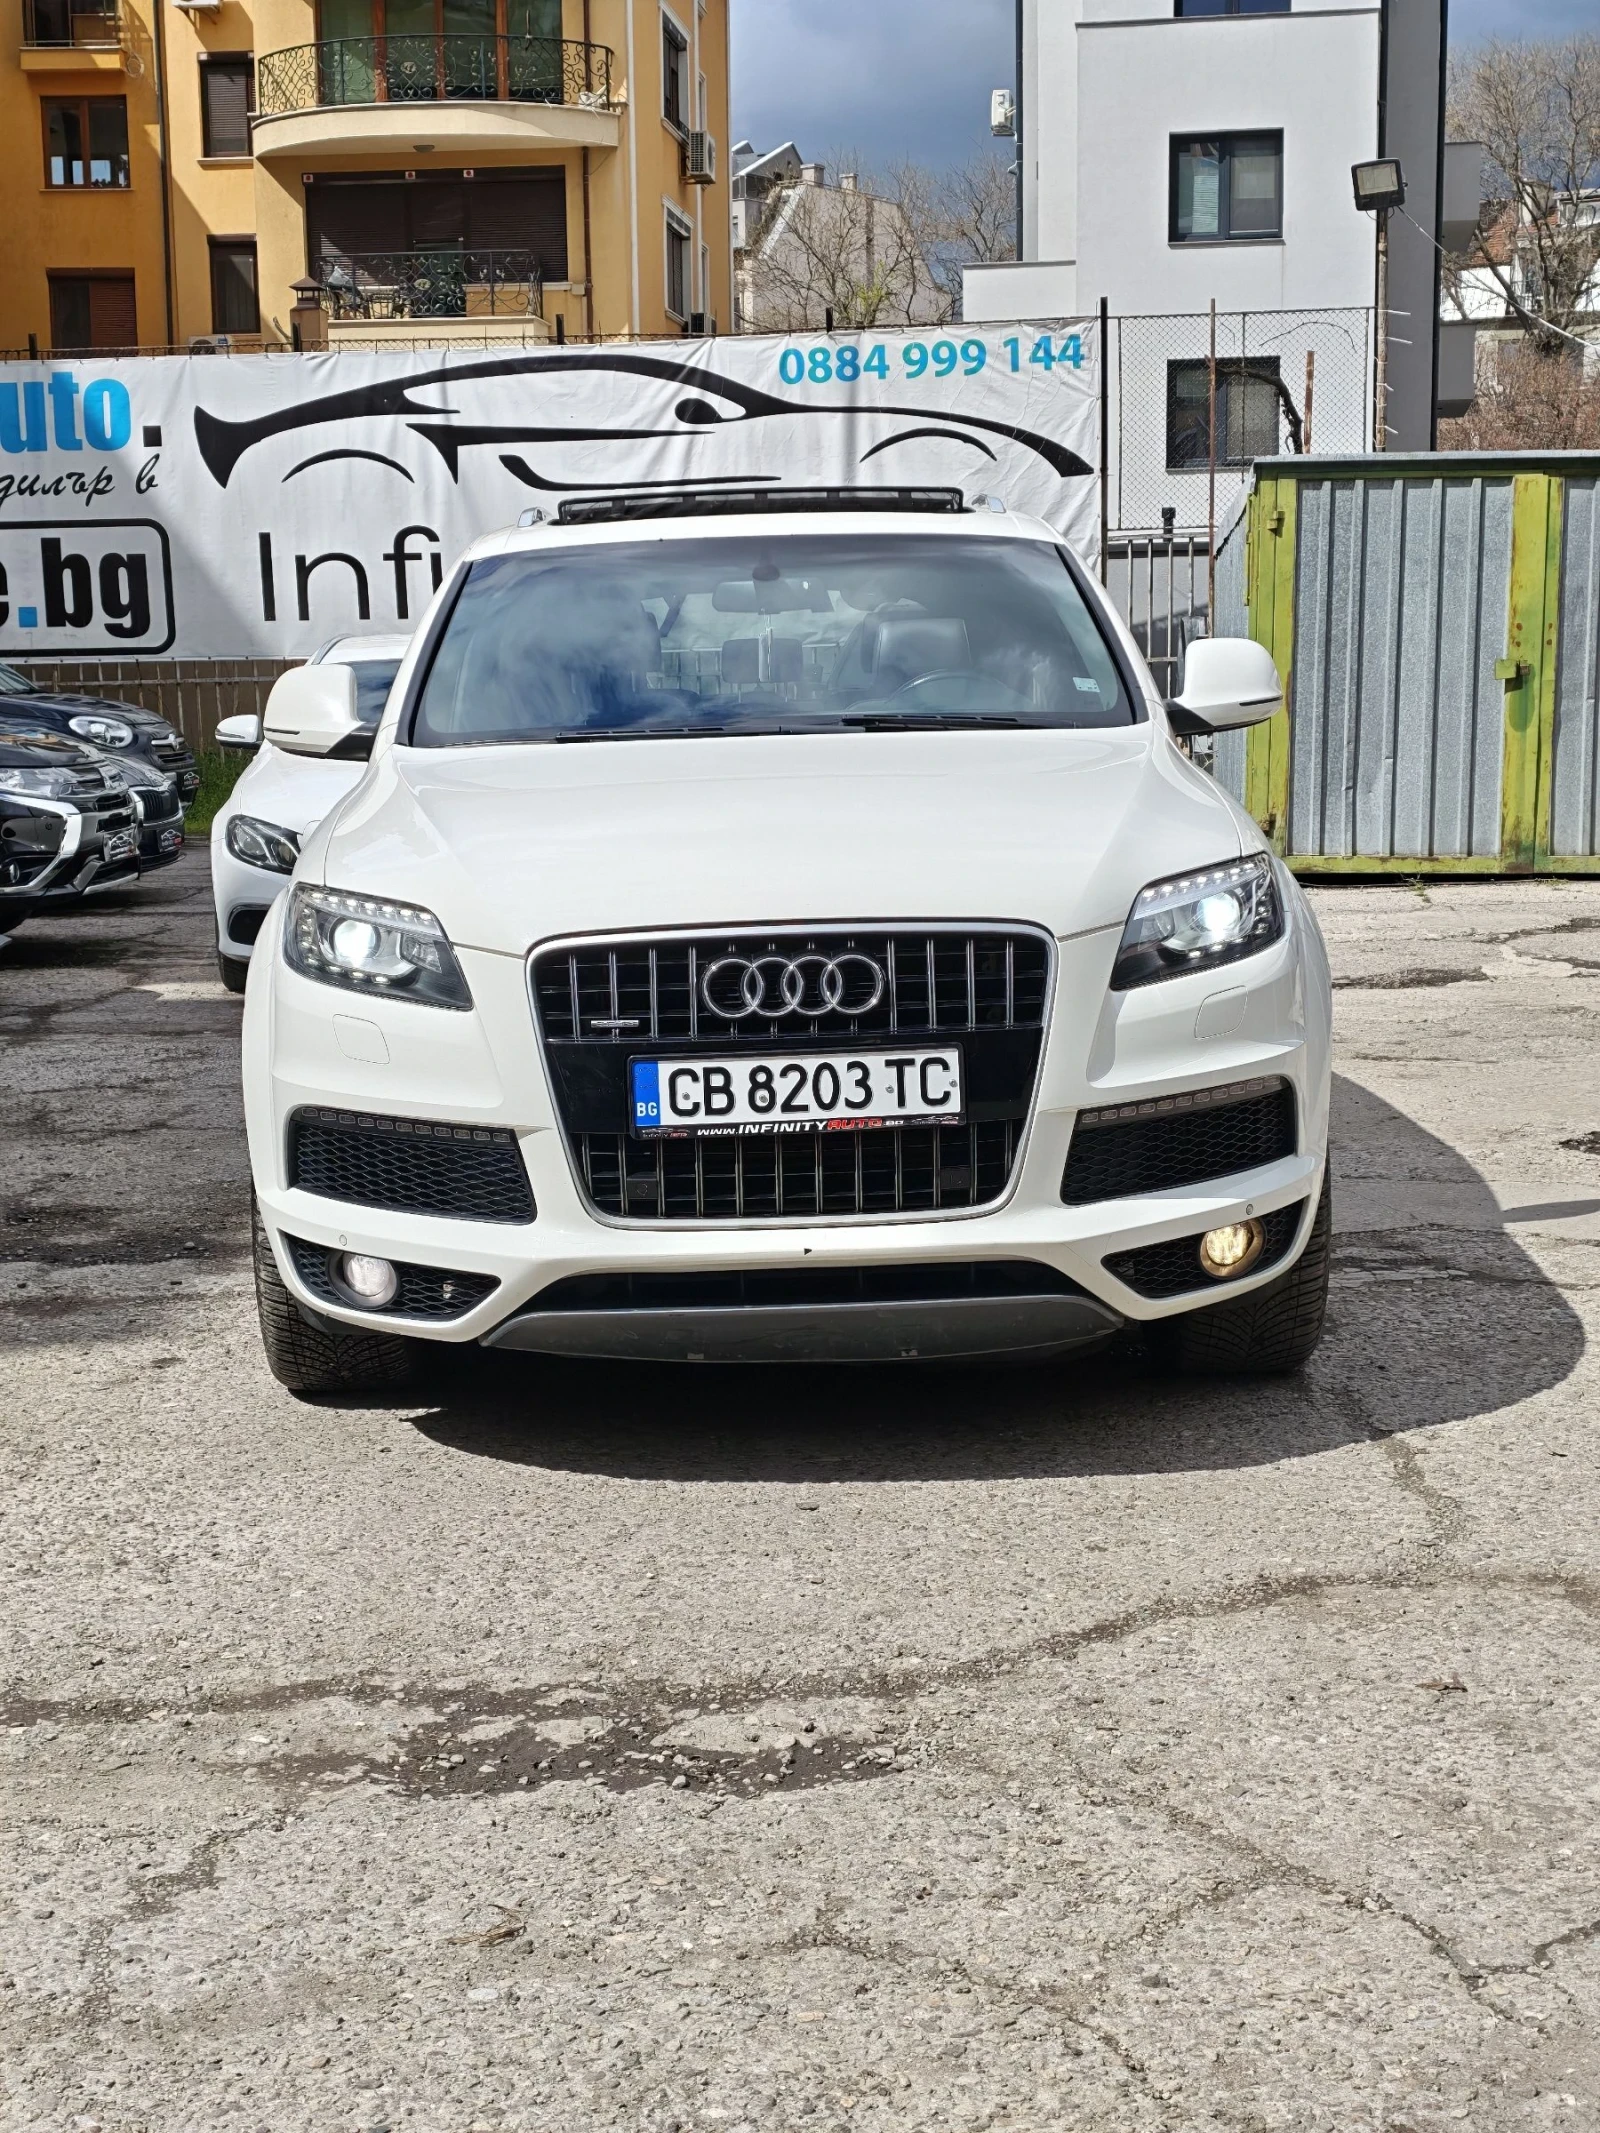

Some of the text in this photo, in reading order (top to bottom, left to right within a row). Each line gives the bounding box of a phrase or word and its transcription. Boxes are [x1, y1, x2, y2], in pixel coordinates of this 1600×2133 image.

[779, 334, 1085, 384] 0884 999 144
[0, 537, 151, 638] .bg
[637, 1102, 658, 1116] BG
[668, 1057, 950, 1117] CB 8203 TC
